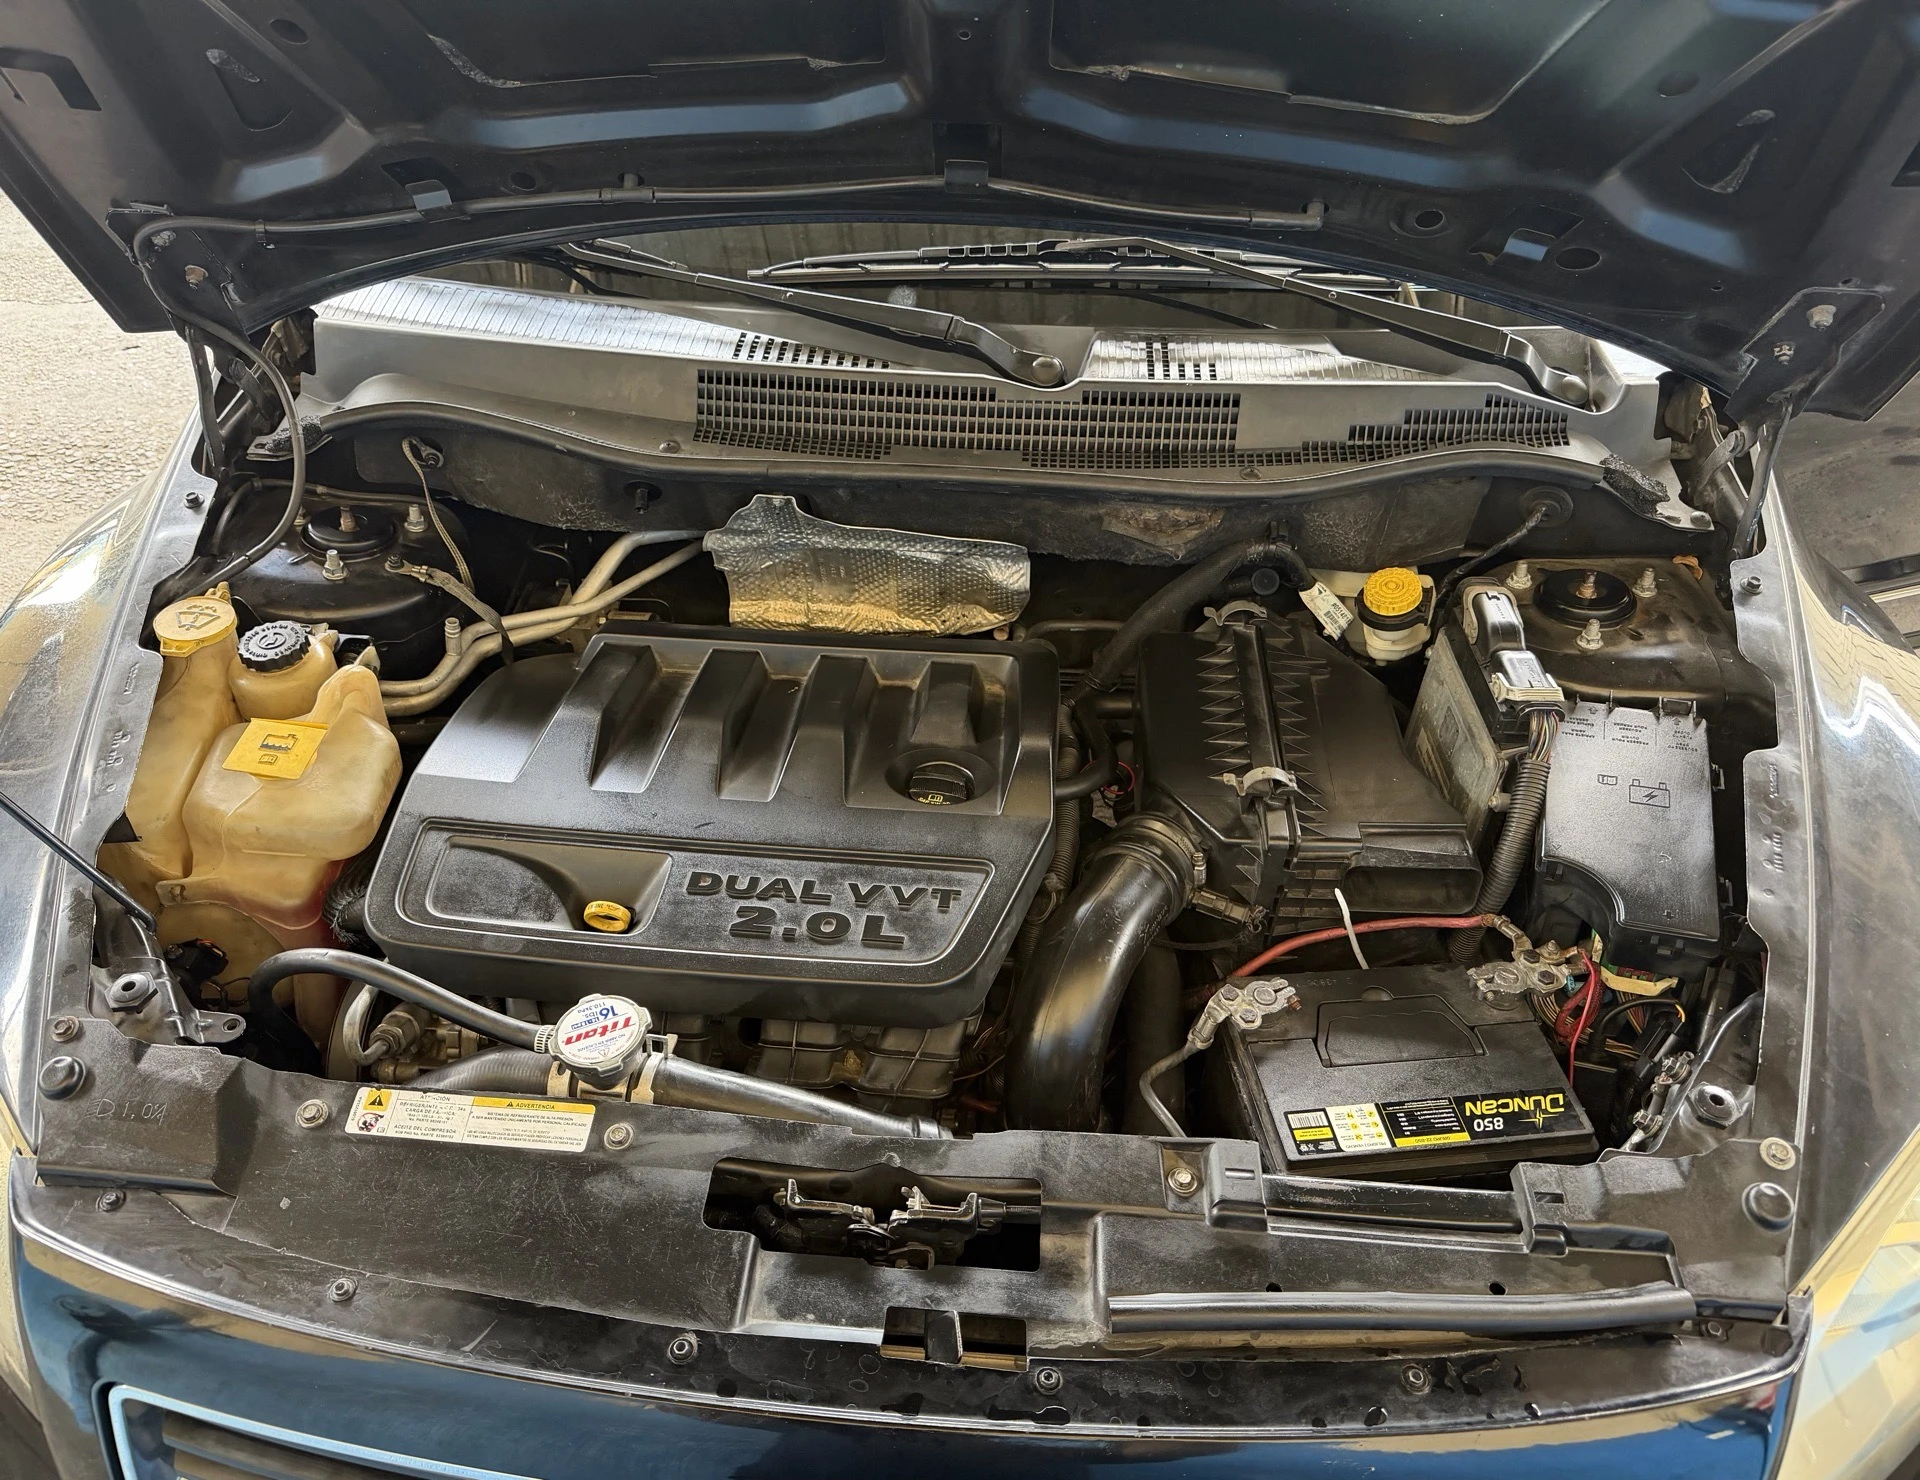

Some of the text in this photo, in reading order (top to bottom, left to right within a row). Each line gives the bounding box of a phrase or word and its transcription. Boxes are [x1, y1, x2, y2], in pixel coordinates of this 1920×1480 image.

[686, 870, 962, 912] DUAL VVT
[729, 905, 906, 949] 2.0L
[600, 1006, 618, 1020] 16
[564, 1016, 634, 1045] Titan
[1474, 1117, 1504, 1132] 850
